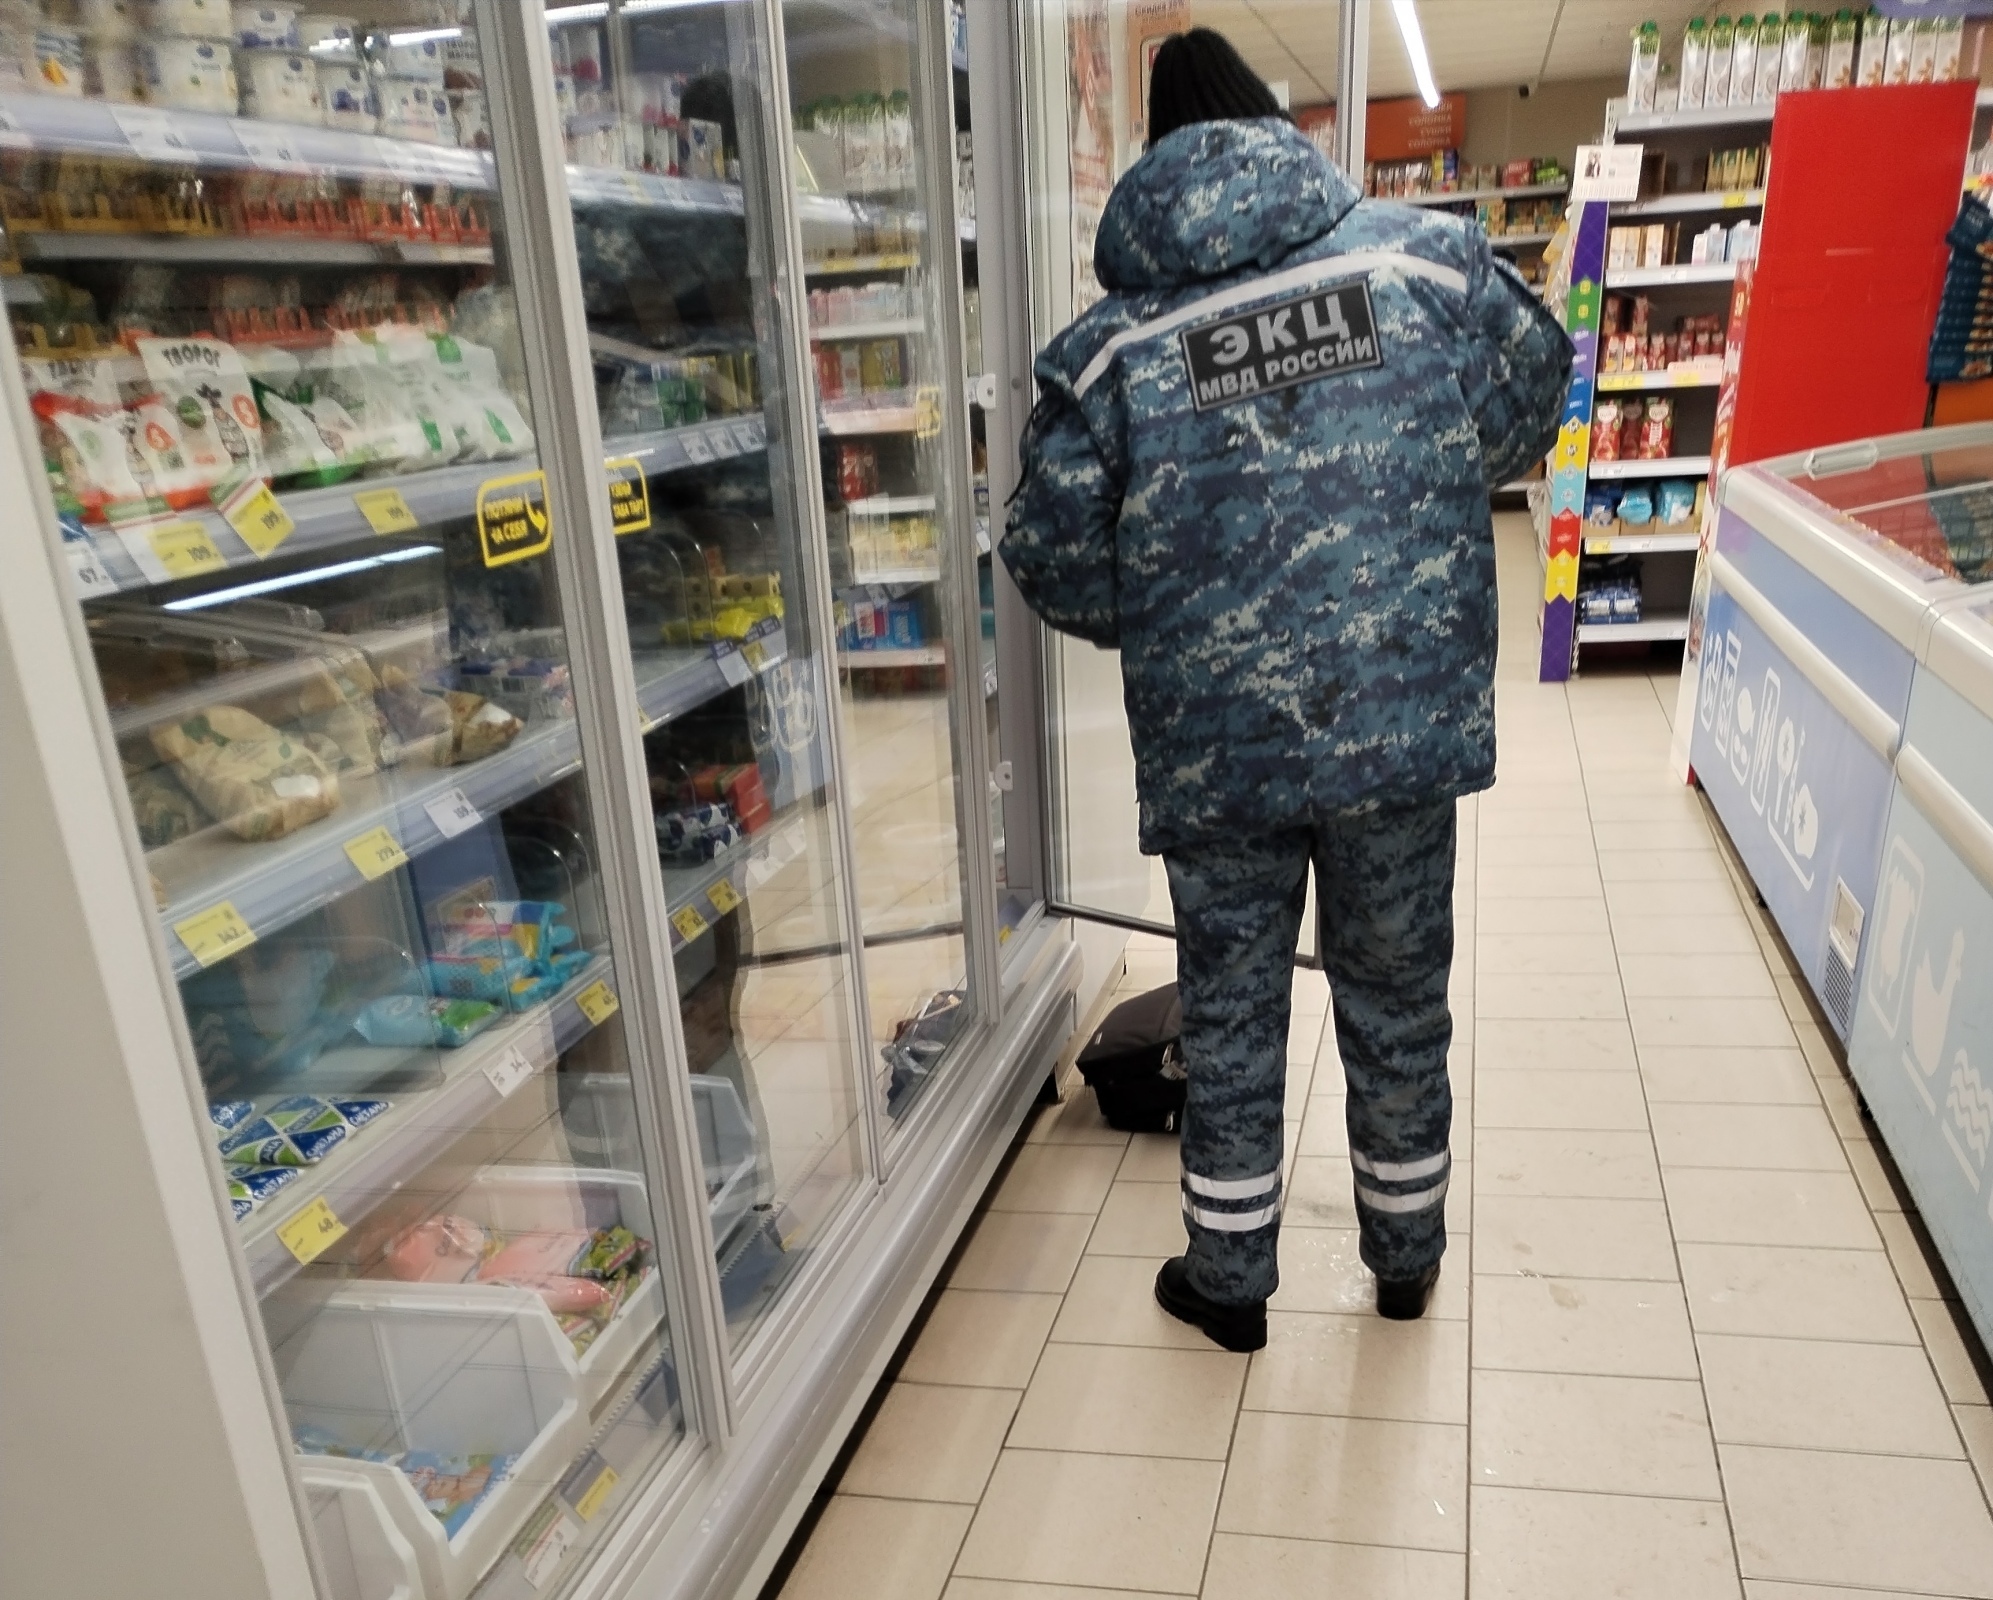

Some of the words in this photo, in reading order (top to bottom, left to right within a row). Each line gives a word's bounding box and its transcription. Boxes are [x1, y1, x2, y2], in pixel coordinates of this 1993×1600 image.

[1209, 293, 1350, 366] ЭКЦ
[1199, 365, 1260, 403] МВД
[1265, 336, 1373, 383] РОССИИ
